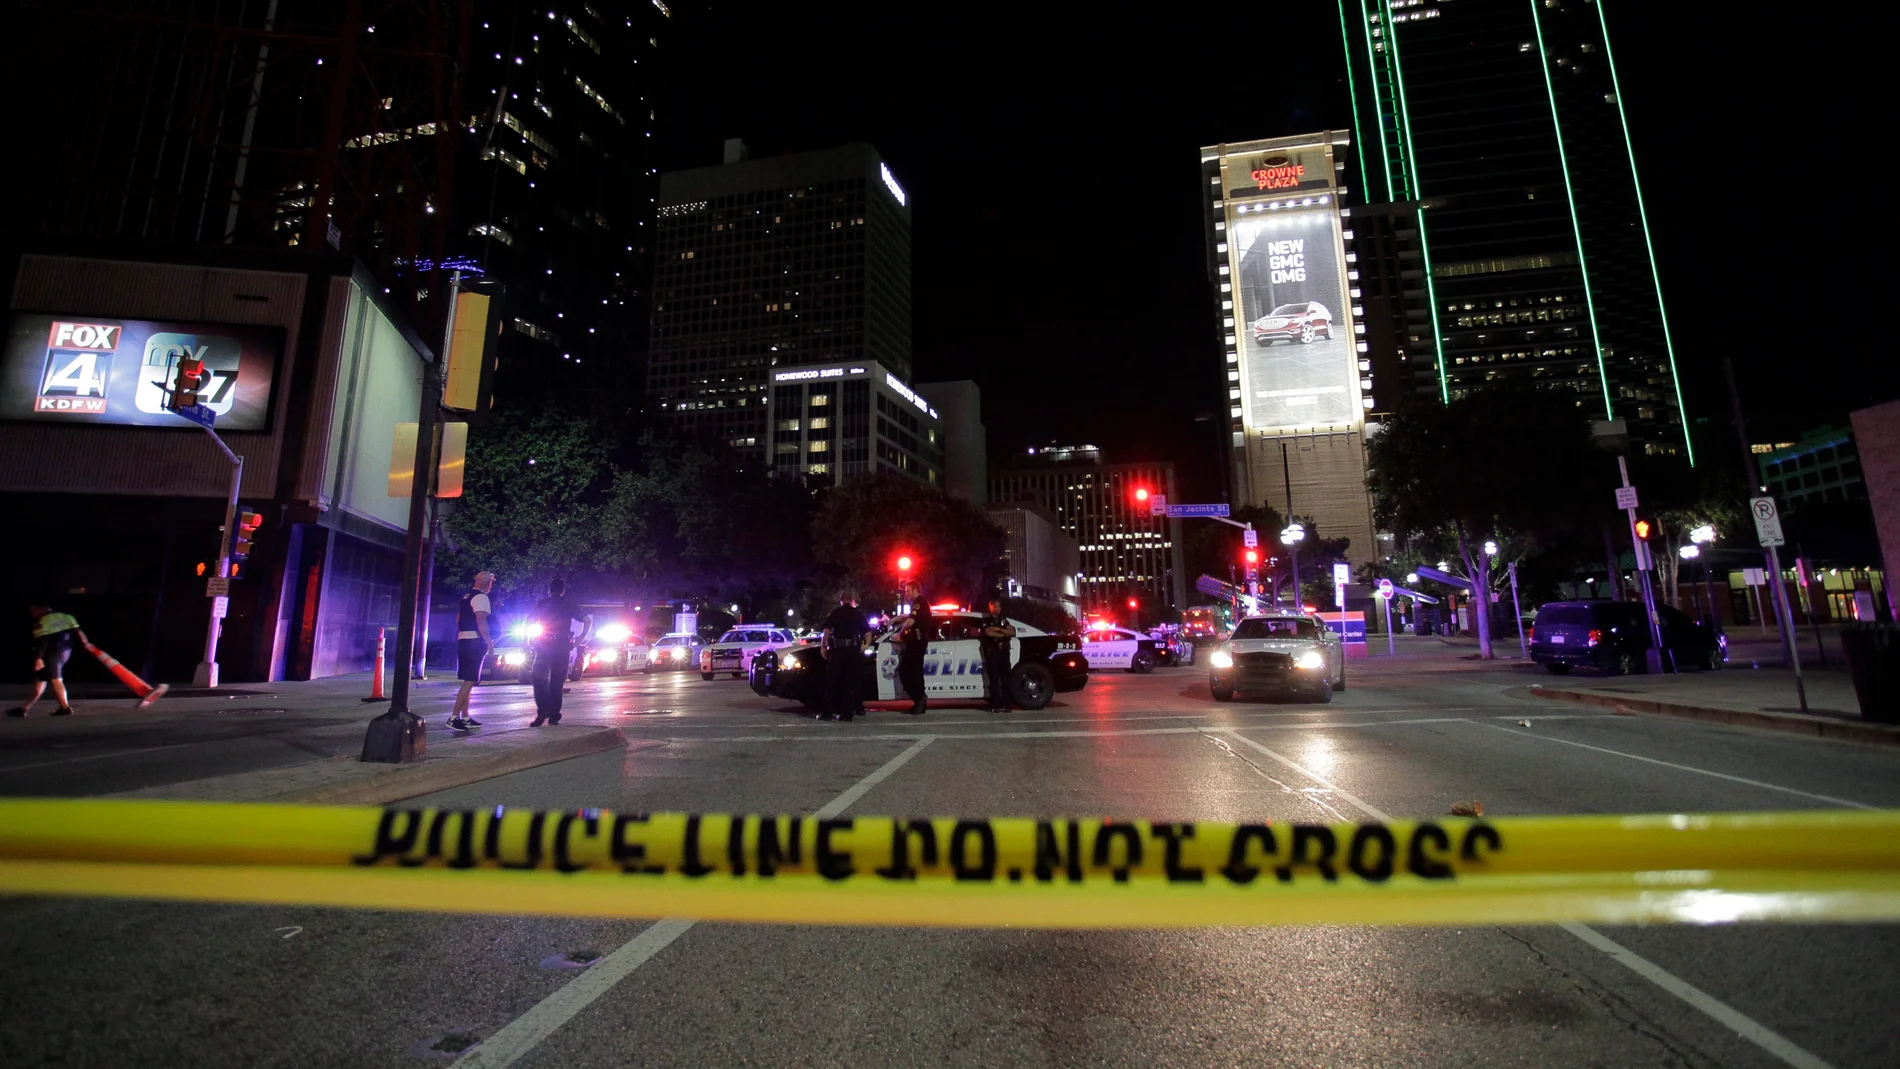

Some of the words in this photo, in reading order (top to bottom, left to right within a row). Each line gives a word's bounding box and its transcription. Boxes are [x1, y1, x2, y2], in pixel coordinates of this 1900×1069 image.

[1251, 165, 1304, 181] CROWNE
[1258, 177, 1299, 190] PLAZA
[1268, 239, 1303, 255] NEW
[1270, 253, 1304, 269] GMC
[1271, 267, 1306, 283] OMG
[55, 324, 113, 349] FOX
[46, 353, 102, 396] 4
[775, 370, 819, 381] HOMEWOOD
[820, 368, 843, 377] SUITES
[40, 399, 104, 410] KDFW
[1168, 505, 1182, 513] San
[1185, 504, 1214, 513] Jacinto
[1217, 503, 1228, 512] St.
[923, 658, 983, 676] OLIC
[679, 813, 858, 881] LINE
[875, 817, 997, 882] DO
[1034, 818, 1205, 882] NOT
[1221, 819, 1504, 886] CROSS
